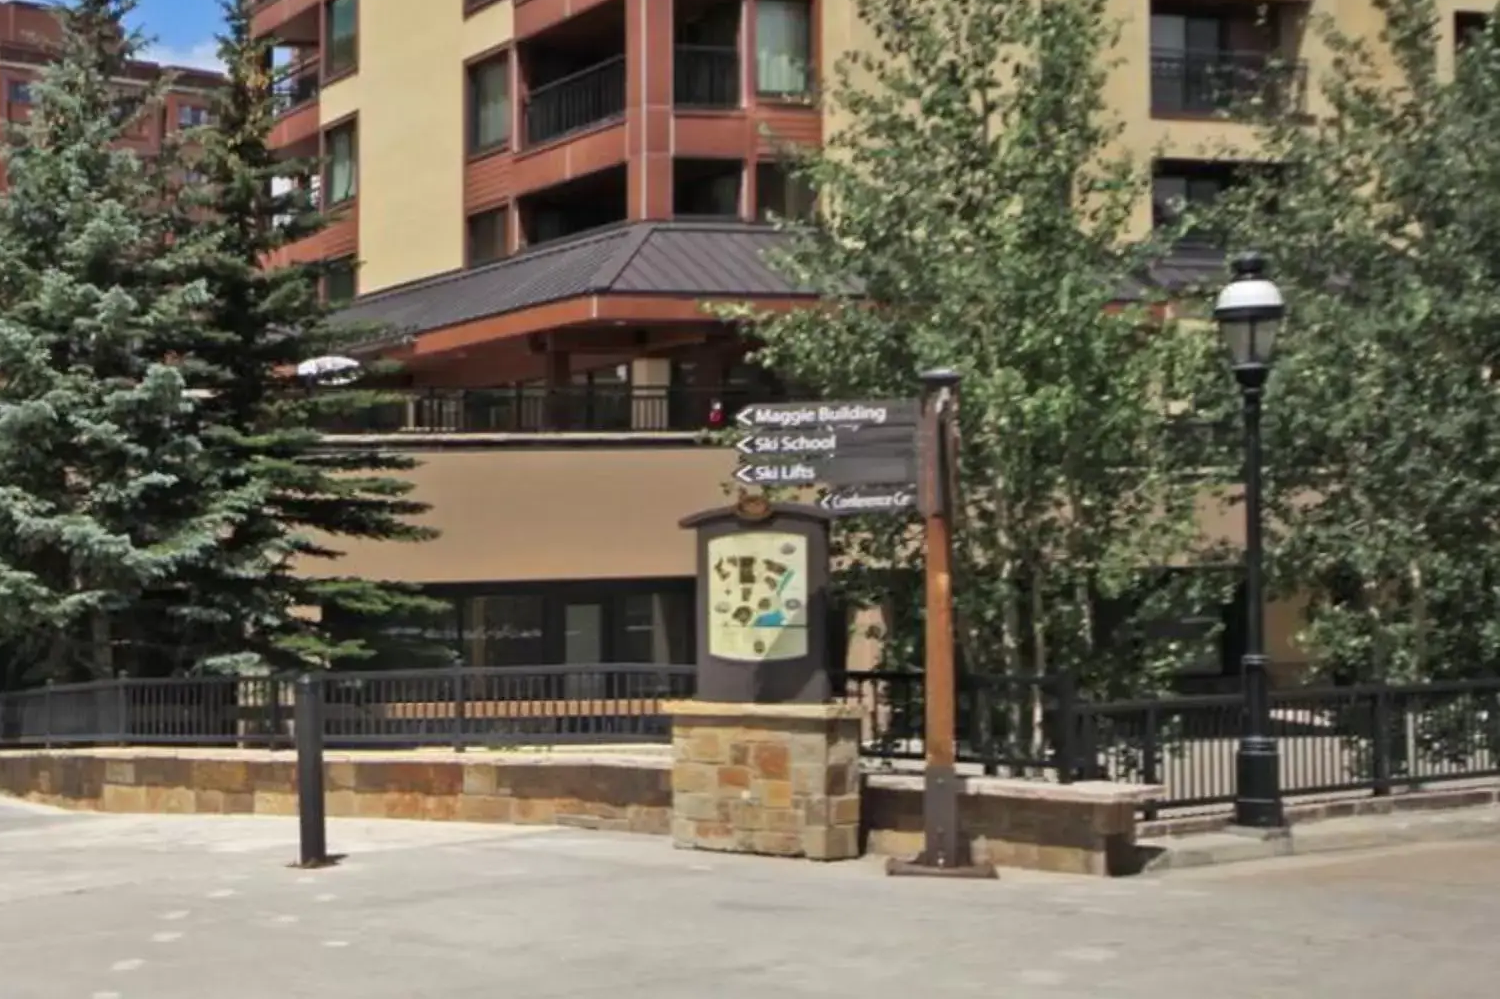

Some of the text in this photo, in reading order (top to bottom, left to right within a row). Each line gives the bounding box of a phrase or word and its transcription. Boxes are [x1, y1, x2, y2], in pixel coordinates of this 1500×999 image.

[755, 404, 887, 425] Maggie Building
[754, 434, 837, 450] Ski School
[754, 463, 815, 480] Ski Lifts
